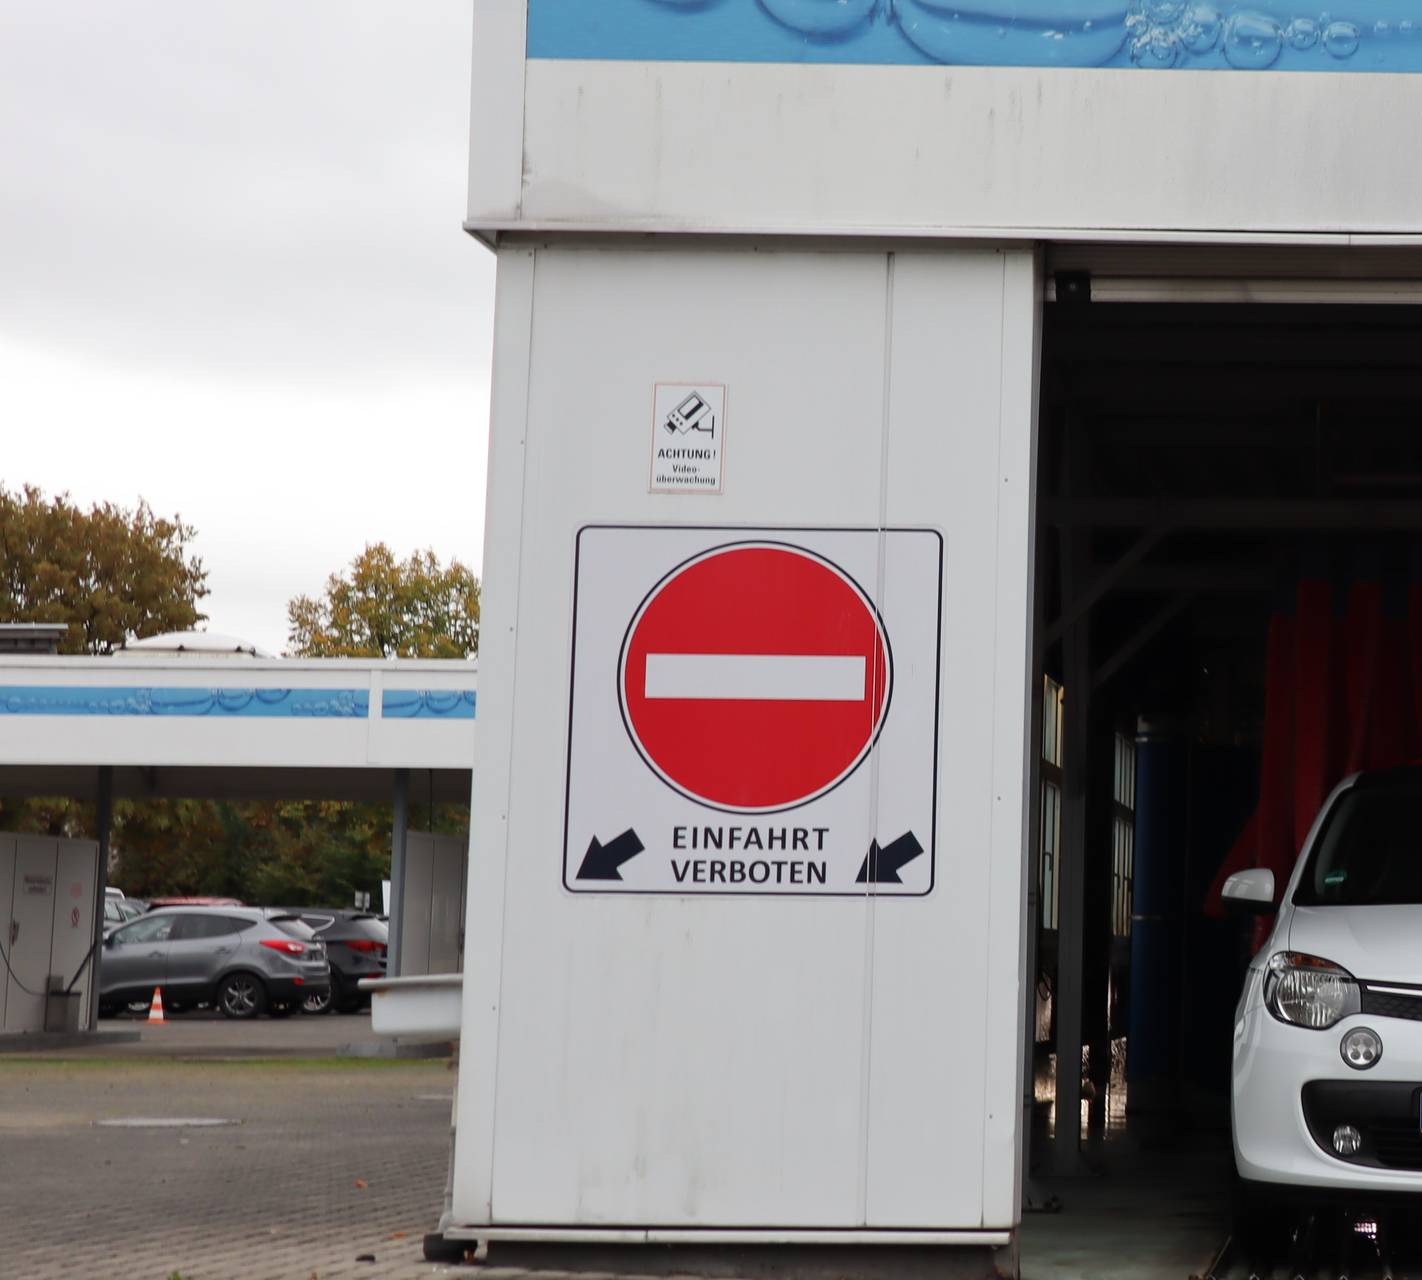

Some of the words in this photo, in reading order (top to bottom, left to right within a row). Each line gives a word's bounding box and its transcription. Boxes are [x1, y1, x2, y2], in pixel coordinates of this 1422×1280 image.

[656, 474, 716, 486] überwachung
[672, 826, 830, 851] EINFAHRT
[670, 859, 827, 884] VERBOTEN
